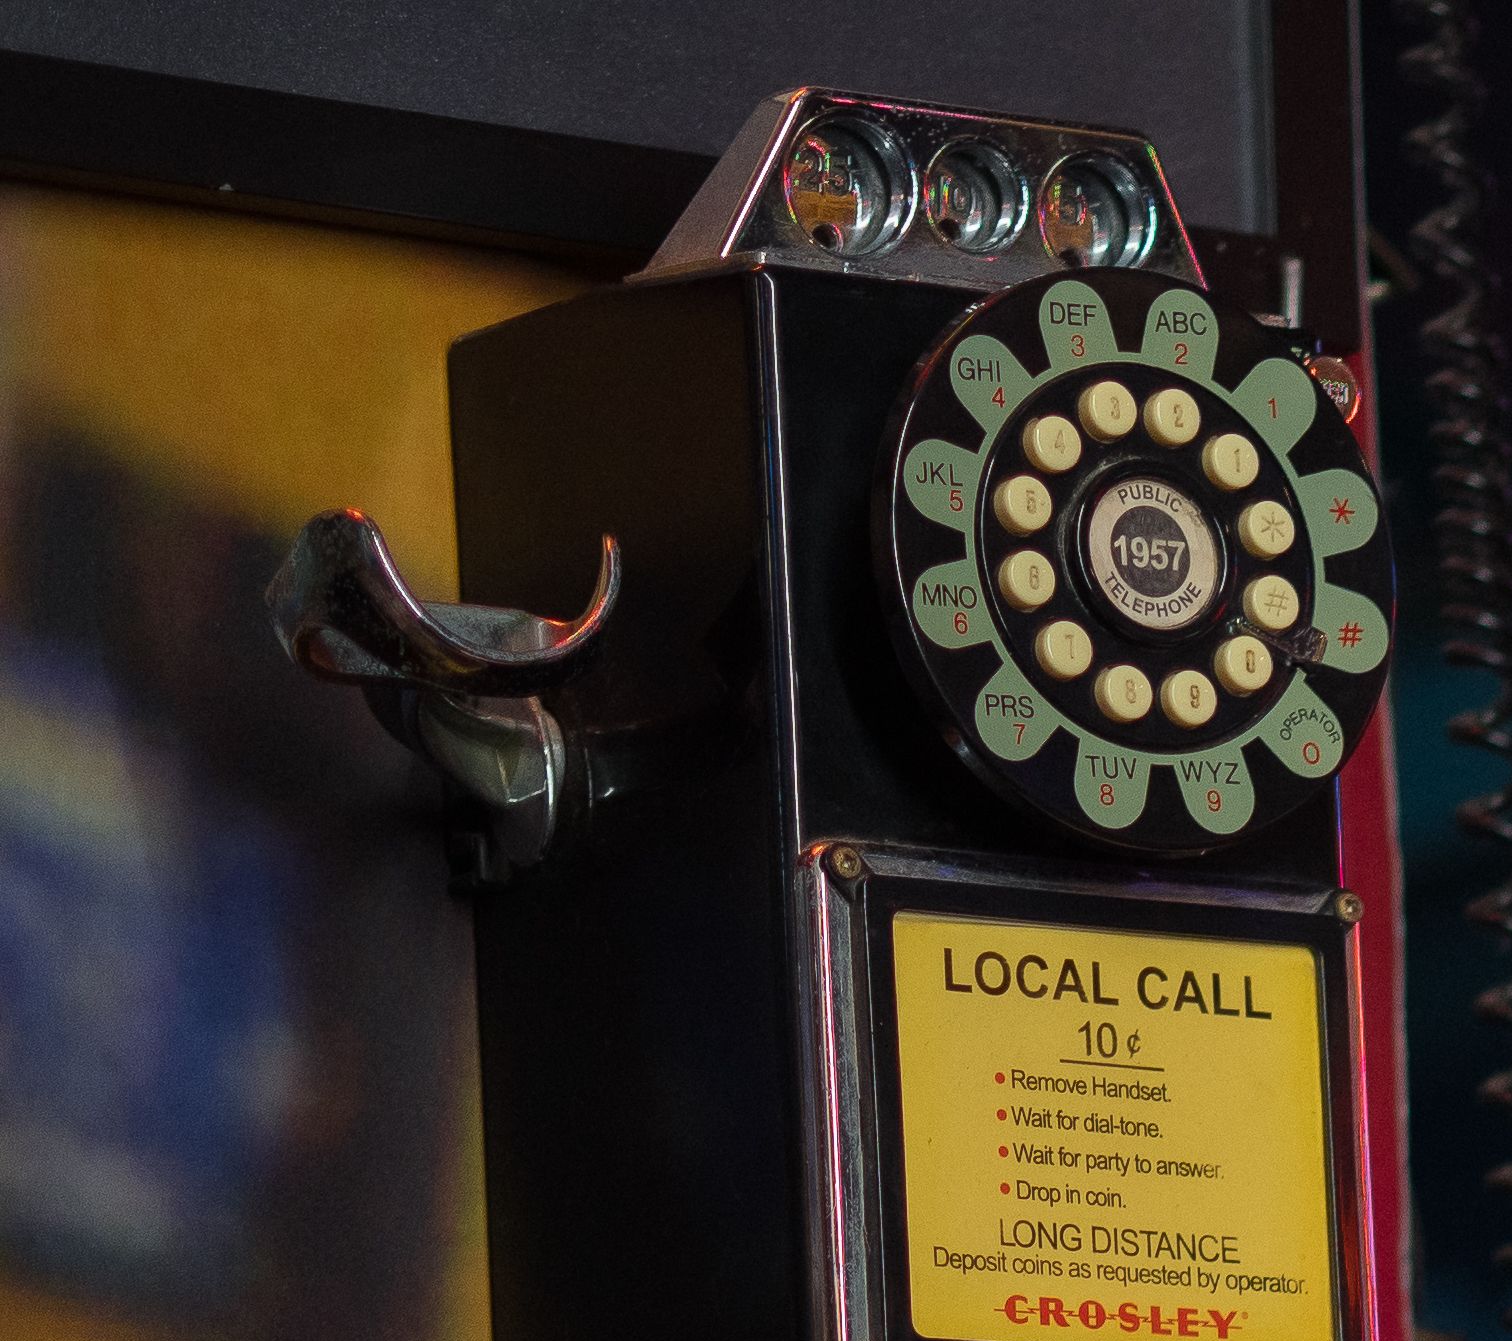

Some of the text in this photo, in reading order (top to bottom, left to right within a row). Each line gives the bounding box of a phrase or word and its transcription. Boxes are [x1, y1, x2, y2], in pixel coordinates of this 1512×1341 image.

[1050, 301, 1097, 326] DEF
[1154, 311, 1207, 336] ABC
[1070, 335, 1085, 357] 3
[1175, 343, 1188, 365] 2
[957, 357, 1001, 383] GHI
[991, 387, 1006, 408] 4
[1110, 396, 1121, 418] 3
[1267, 397, 1278, 419] 1
[1173, 403, 1184, 428] 2
[1054, 429, 1065, 454] 4
[1233, 448, 1241, 474] 1
[916, 461, 963, 487] JKL
[949, 489, 964, 512] 5
[1117, 484, 1182, 513] PUBLIC
[1113, 534, 1186, 572] 1957
[1029, 565, 1040, 590] 6
[921, 582, 977, 609] MNO
[1104, 571, 1202, 618] TELEPHONE
[954, 612, 969, 635] 6
[1126, 678, 1136, 704] 8
[1190, 684, 1200, 709] 9
[985, 694, 1035, 719] PRS
[1012, 723, 1025, 745] 7
[1279, 708, 1341, 744] OPERATOR
[1302, 741, 1320, 765] 0
[1084, 755, 1137, 780] TUV
[1180, 760, 1241, 785] WYZ
[1099, 783, 1115, 806] 8
[1206, 789, 1222, 812] 9
[943, 946, 1273, 1020] LOCAL CALL
[1077, 1020, 1118, 1059] 10
[1011, 1069, 1172, 1102] Remove Handset.
[1011, 1106, 1164, 1139] Wait for dial-tone.
[1013, 1142, 1225, 1180] Wait for party to answer.
[1016, 1179, 1127, 1208] Drop in coin.
[1000, 1217, 1241, 1264] LONG DISTANCE
[933, 1245, 1309, 1296] Deposit coins as requested by operator.
[1000, 1293, 1240, 1340] CROSLEY
